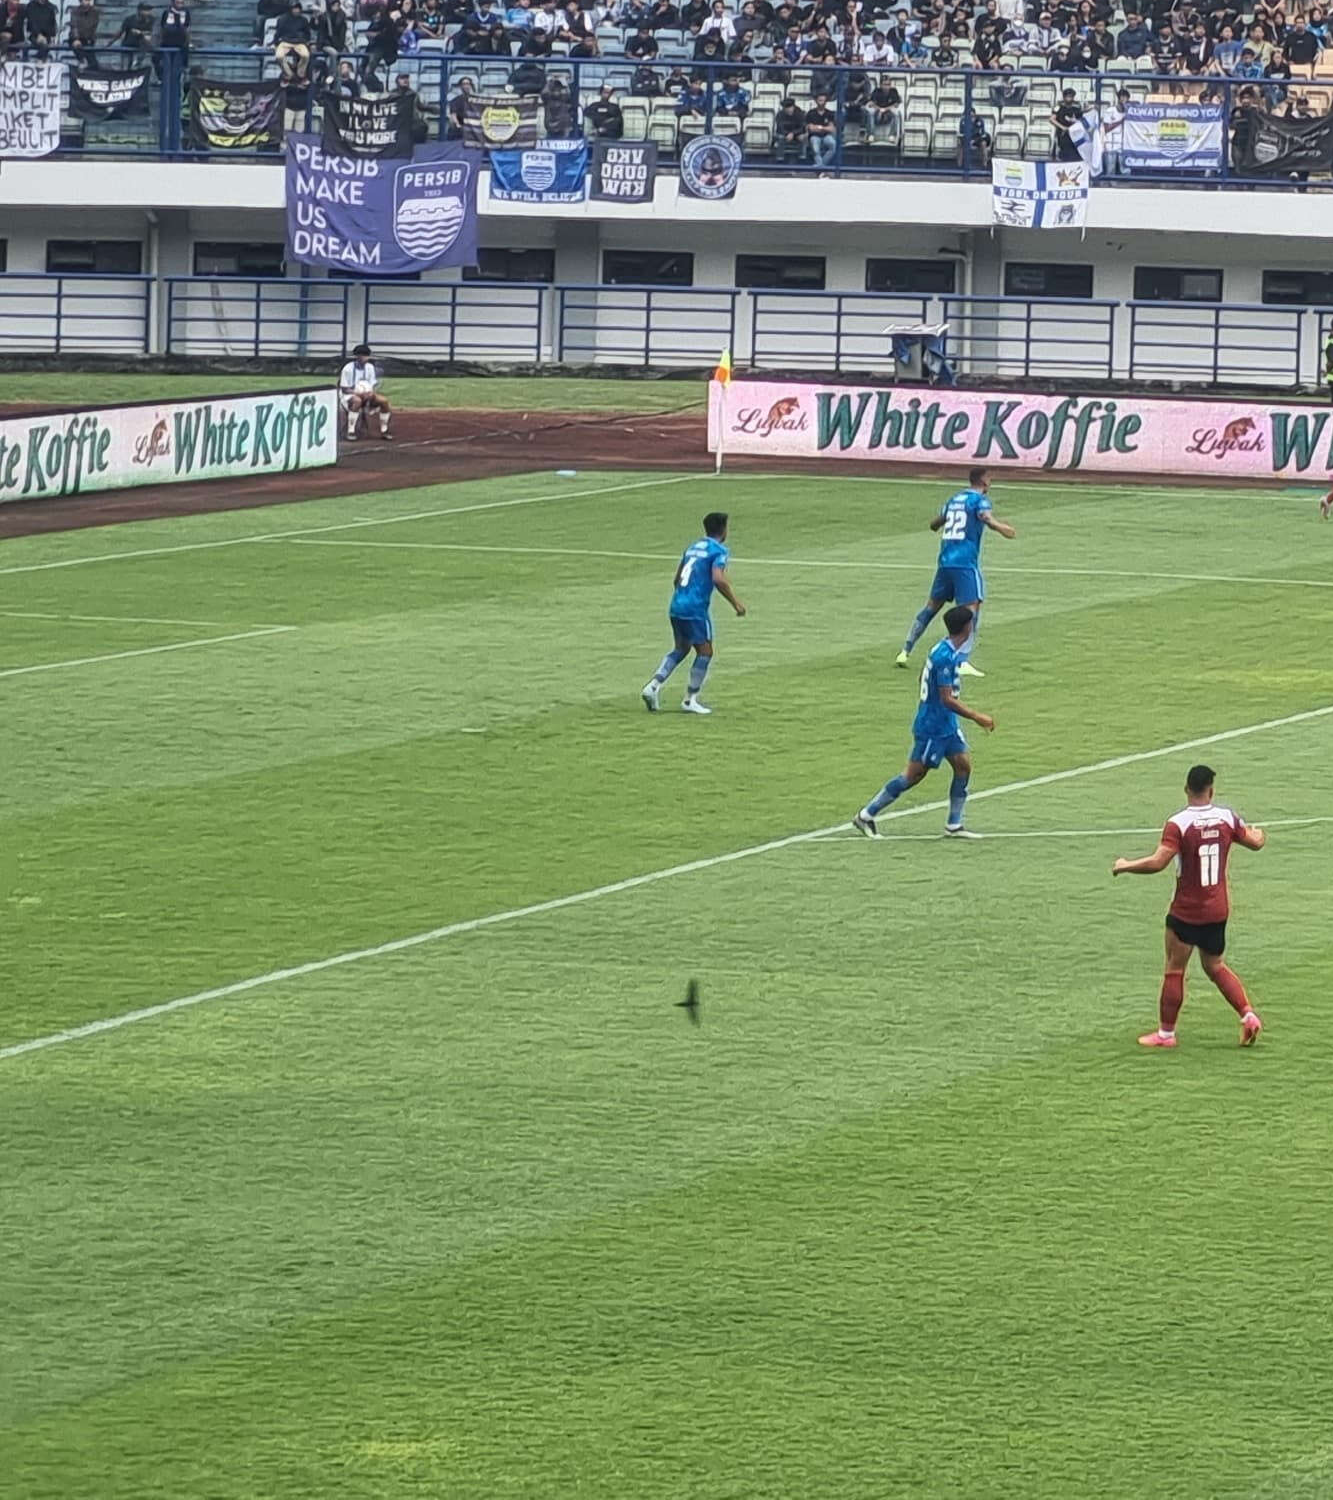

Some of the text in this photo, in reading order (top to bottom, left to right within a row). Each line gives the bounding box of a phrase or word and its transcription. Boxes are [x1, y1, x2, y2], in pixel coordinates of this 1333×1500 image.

[0, 65, 58, 89] MBEL
[0, 90, 58, 111] MPLIT
[296, 171, 366, 206] MAKE
[403, 169, 462, 188] PERSIB
[297, 201, 328, 230] US
[293, 230, 381, 266] DREAM
[173, 404, 250, 474] White
[250, 393, 328, 471] Koffie
[815, 391, 970, 451] White
[972, 396, 1142, 469] Koffie
[22, 416, 111, 495] Koffie
[942, 509, 967, 541] 22
[1198, 842, 1220, 888] 11
